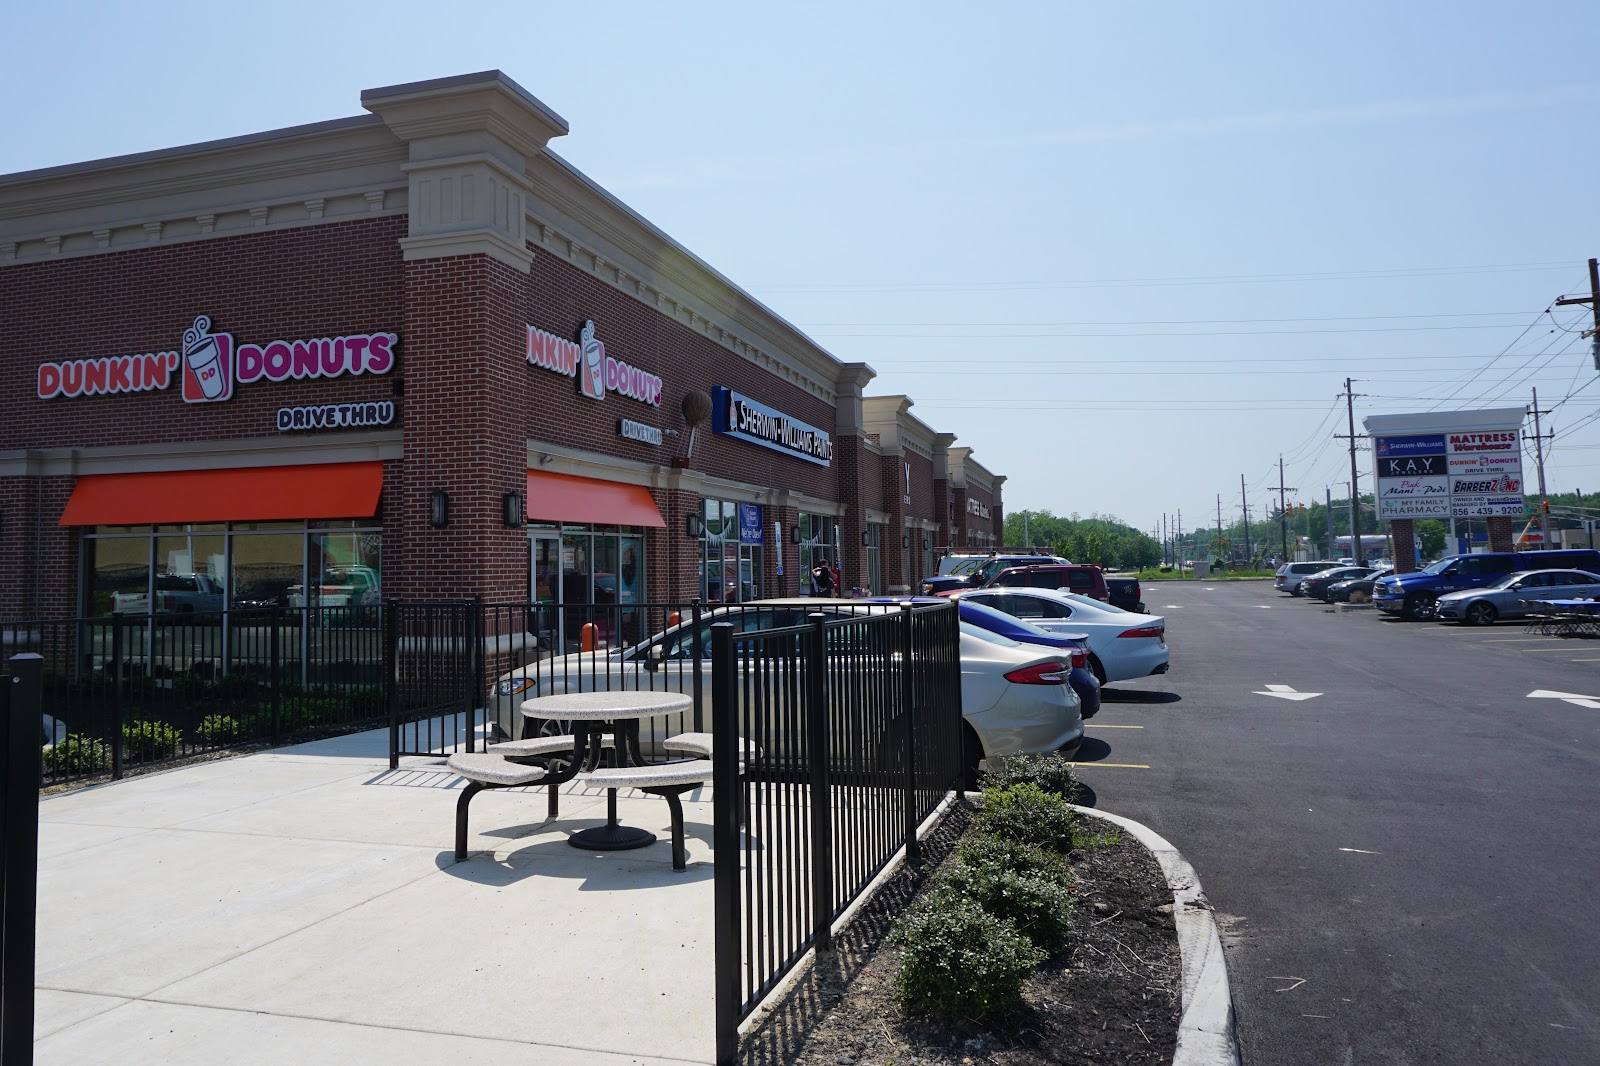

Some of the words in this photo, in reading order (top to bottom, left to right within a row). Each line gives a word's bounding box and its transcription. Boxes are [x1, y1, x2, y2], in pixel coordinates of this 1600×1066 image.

[39, 352, 178, 397] DUNKIN'
[606, 358, 662, 406] DONUTS
[279, 407, 337, 429] DRIVE
[338, 402, 392, 425] THRU
[623, 420, 645, 441] DRIVE
[645, 427, 662, 445] THRU
[740, 401, 812, 453] SHERWIN-WILLIAMS
[814, 432, 832, 460] PAINTS
[1450, 432, 1516, 444] MATTRESS
[1453, 442, 1512, 452] Warehouse
[1390, 458, 1433, 472] KAY
[1400, 477, 1424, 488] Pink
[1383, 487, 1415, 497] Mani
[1422, 485, 1447, 495] Pedi
[1382, 505, 1449, 515] PHARMACY
